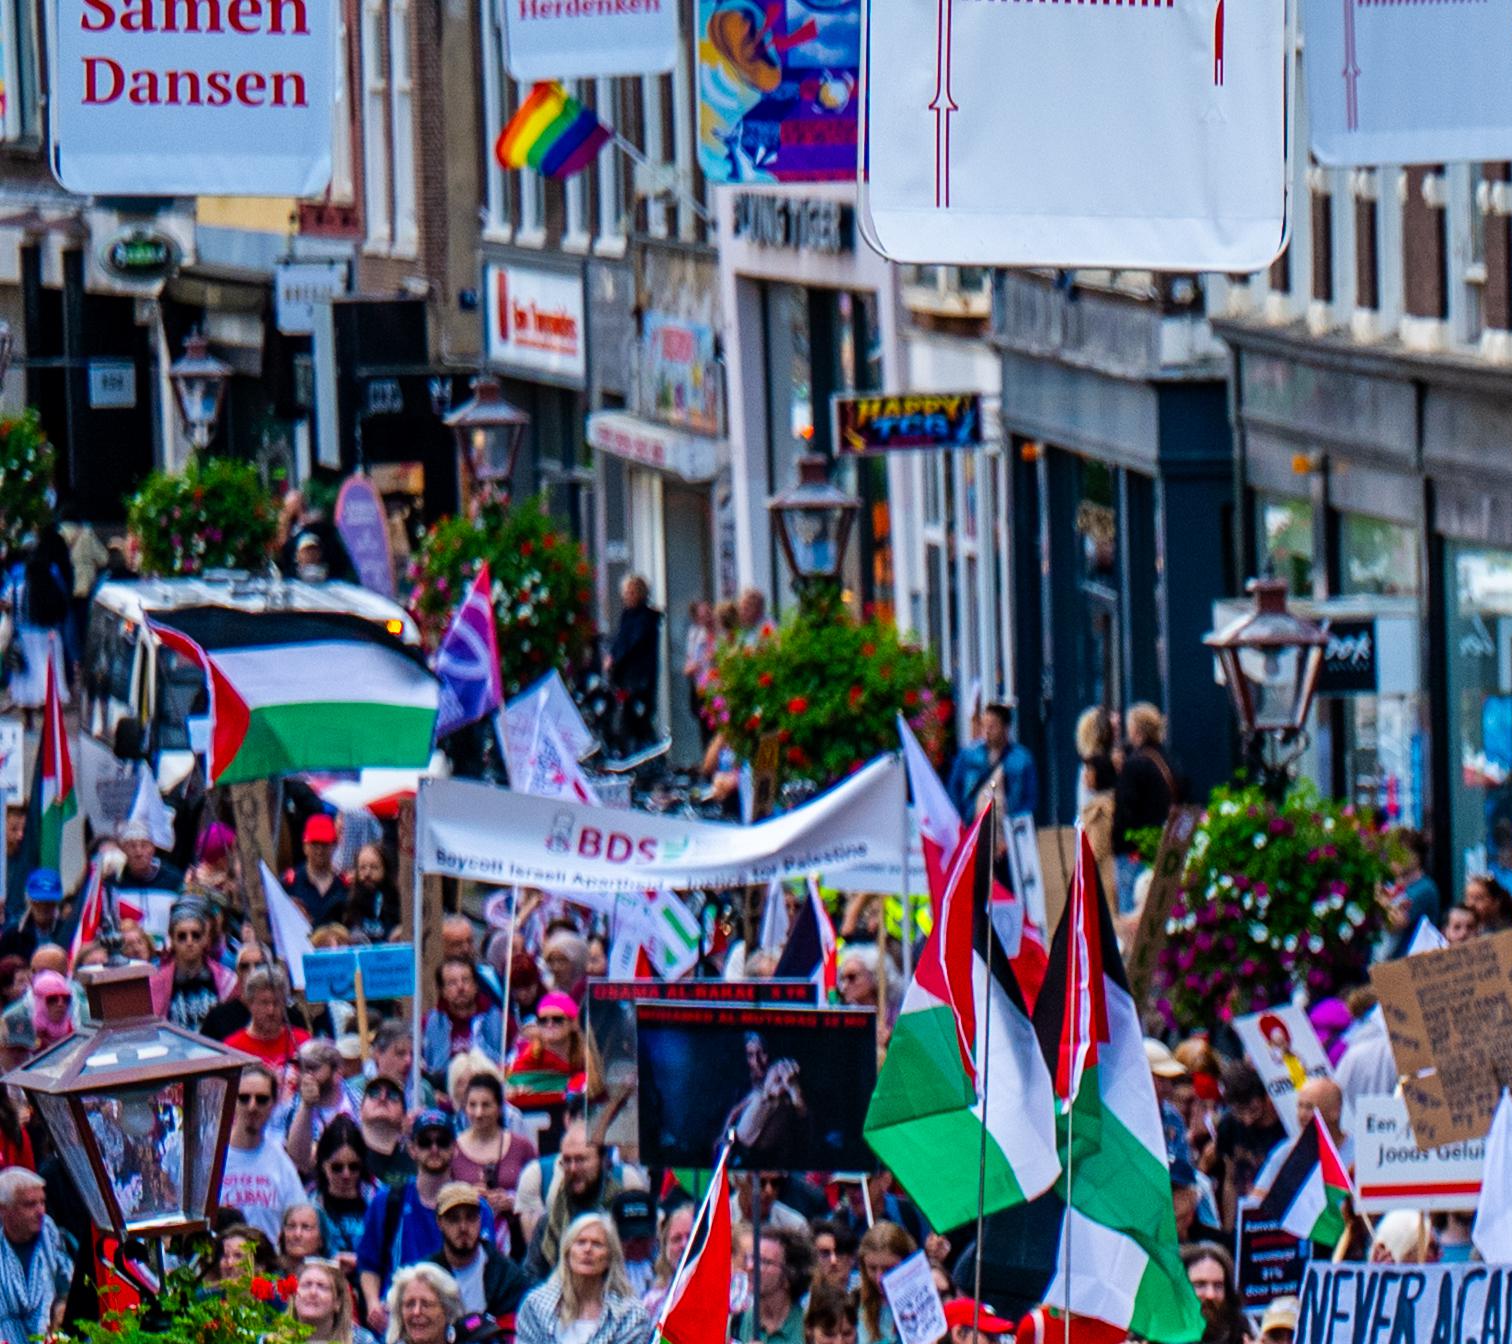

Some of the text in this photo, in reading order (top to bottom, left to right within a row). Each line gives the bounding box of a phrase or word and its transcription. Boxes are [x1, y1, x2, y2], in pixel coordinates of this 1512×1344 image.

[81, 57, 309, 107] Dansen
[578, 828, 659, 864] BDS
[1366, 1112, 1395, 1134] Een
